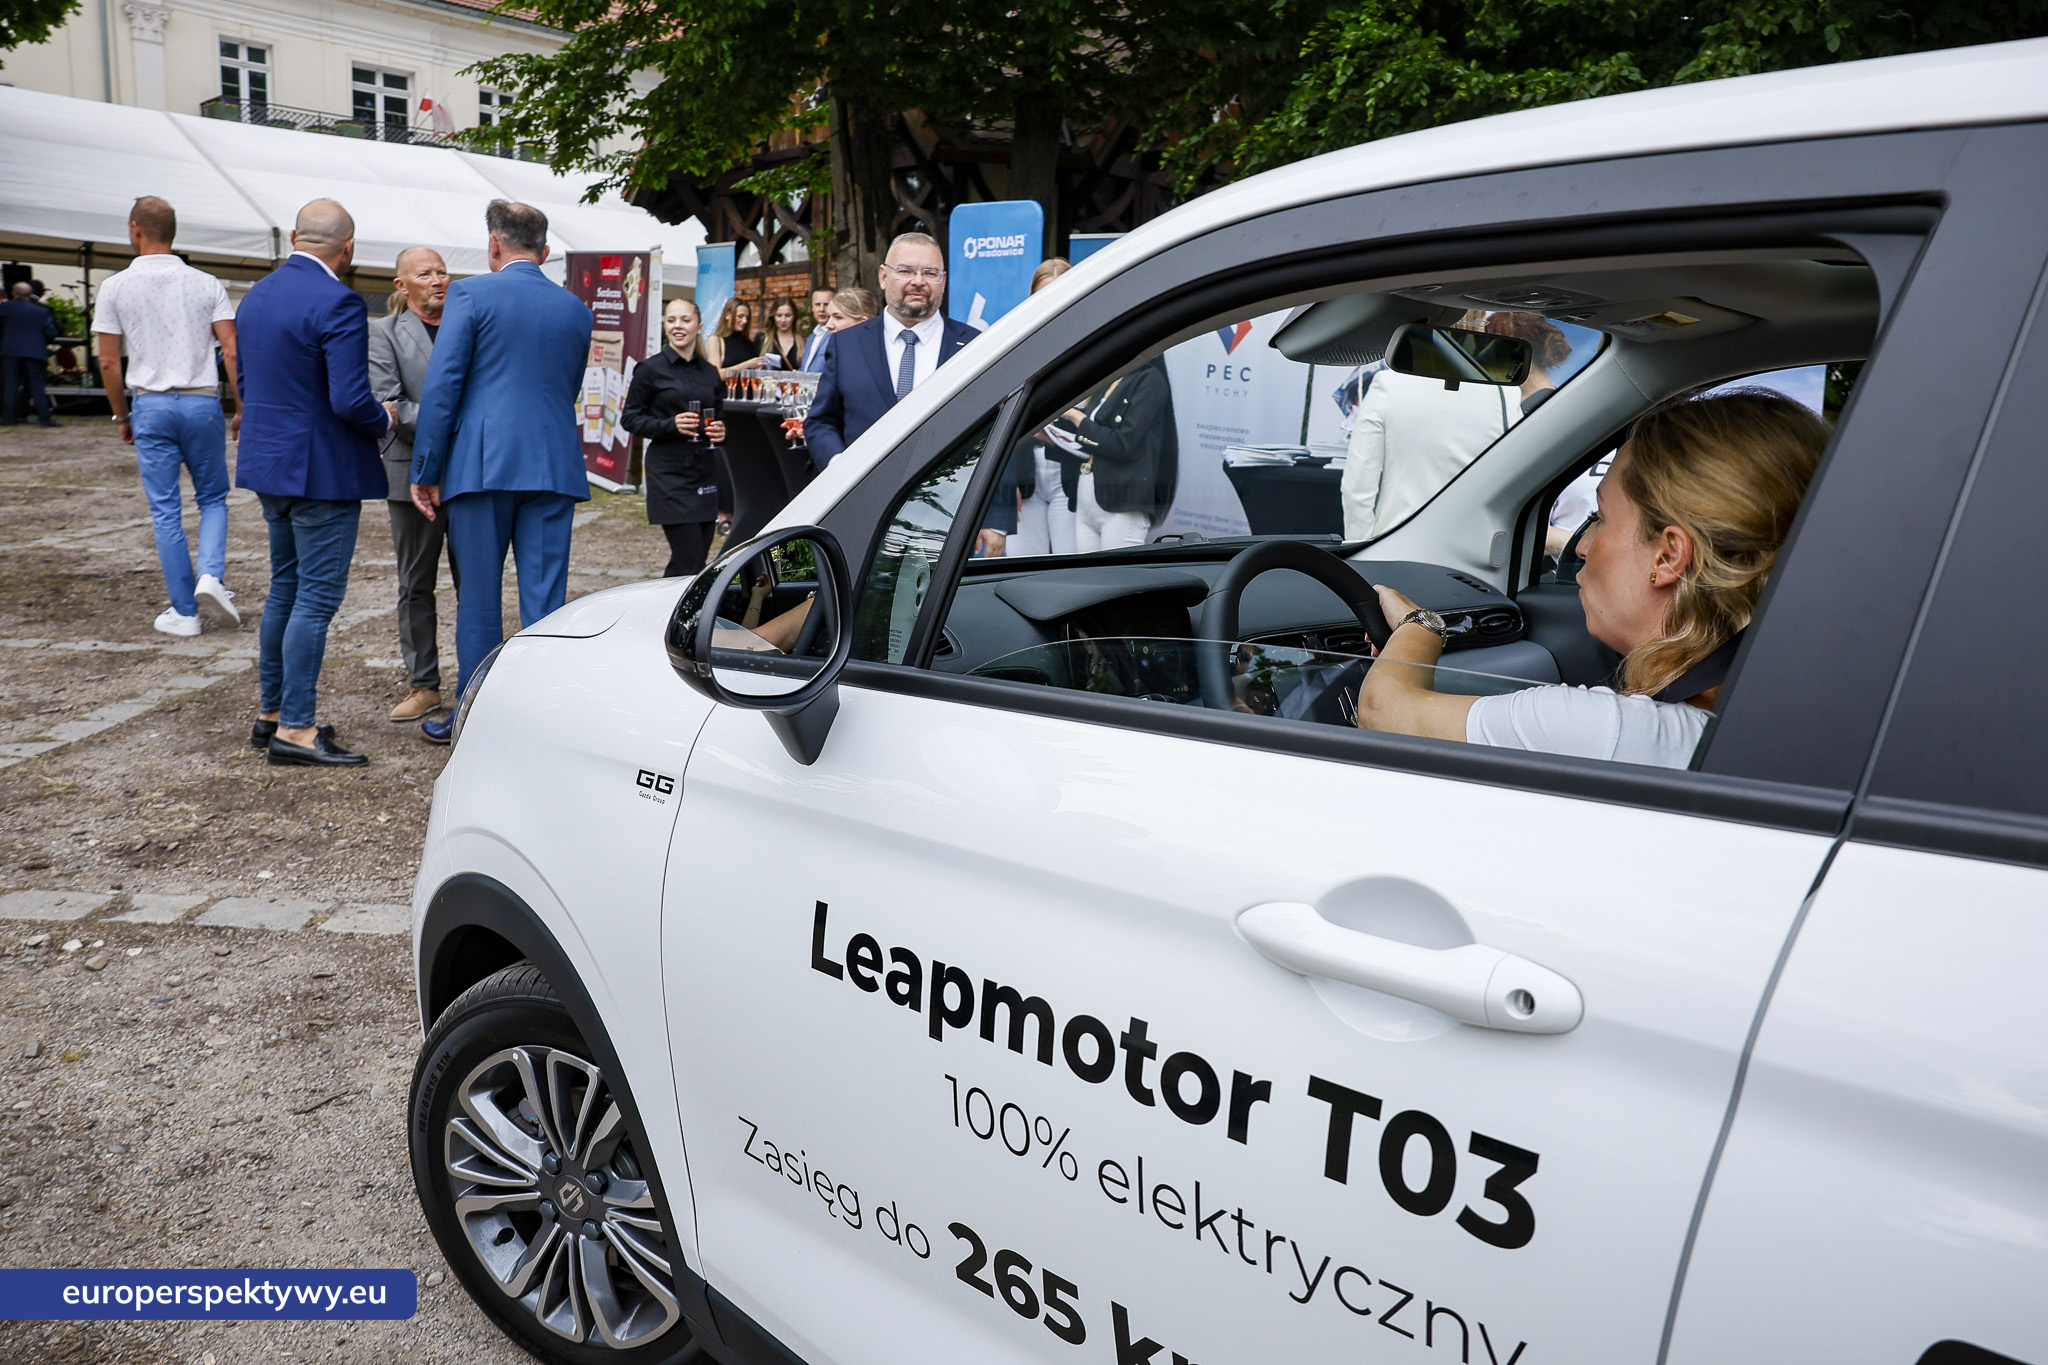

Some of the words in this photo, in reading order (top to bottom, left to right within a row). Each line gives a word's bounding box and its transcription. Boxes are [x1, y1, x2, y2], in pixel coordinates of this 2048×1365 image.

[978, 234, 1025, 249] PONAR
[978, 247, 1024, 258] wadowice
[1206, 364, 1251, 382] PEC
[1205, 385, 1249, 398] TYCHY
[636, 768, 675, 795] GG
[811, 899, 1273, 1146] Leapmotor
[1307, 1074, 1540, 1250] T03
[944, 1073, 1079, 1182] 100%
[737, 1115, 863, 1230] Zasięg
[875, 1200, 931, 1259] do
[947, 1221, 1087, 1346] 265
[1110, 1299, 1200, 1365] k
